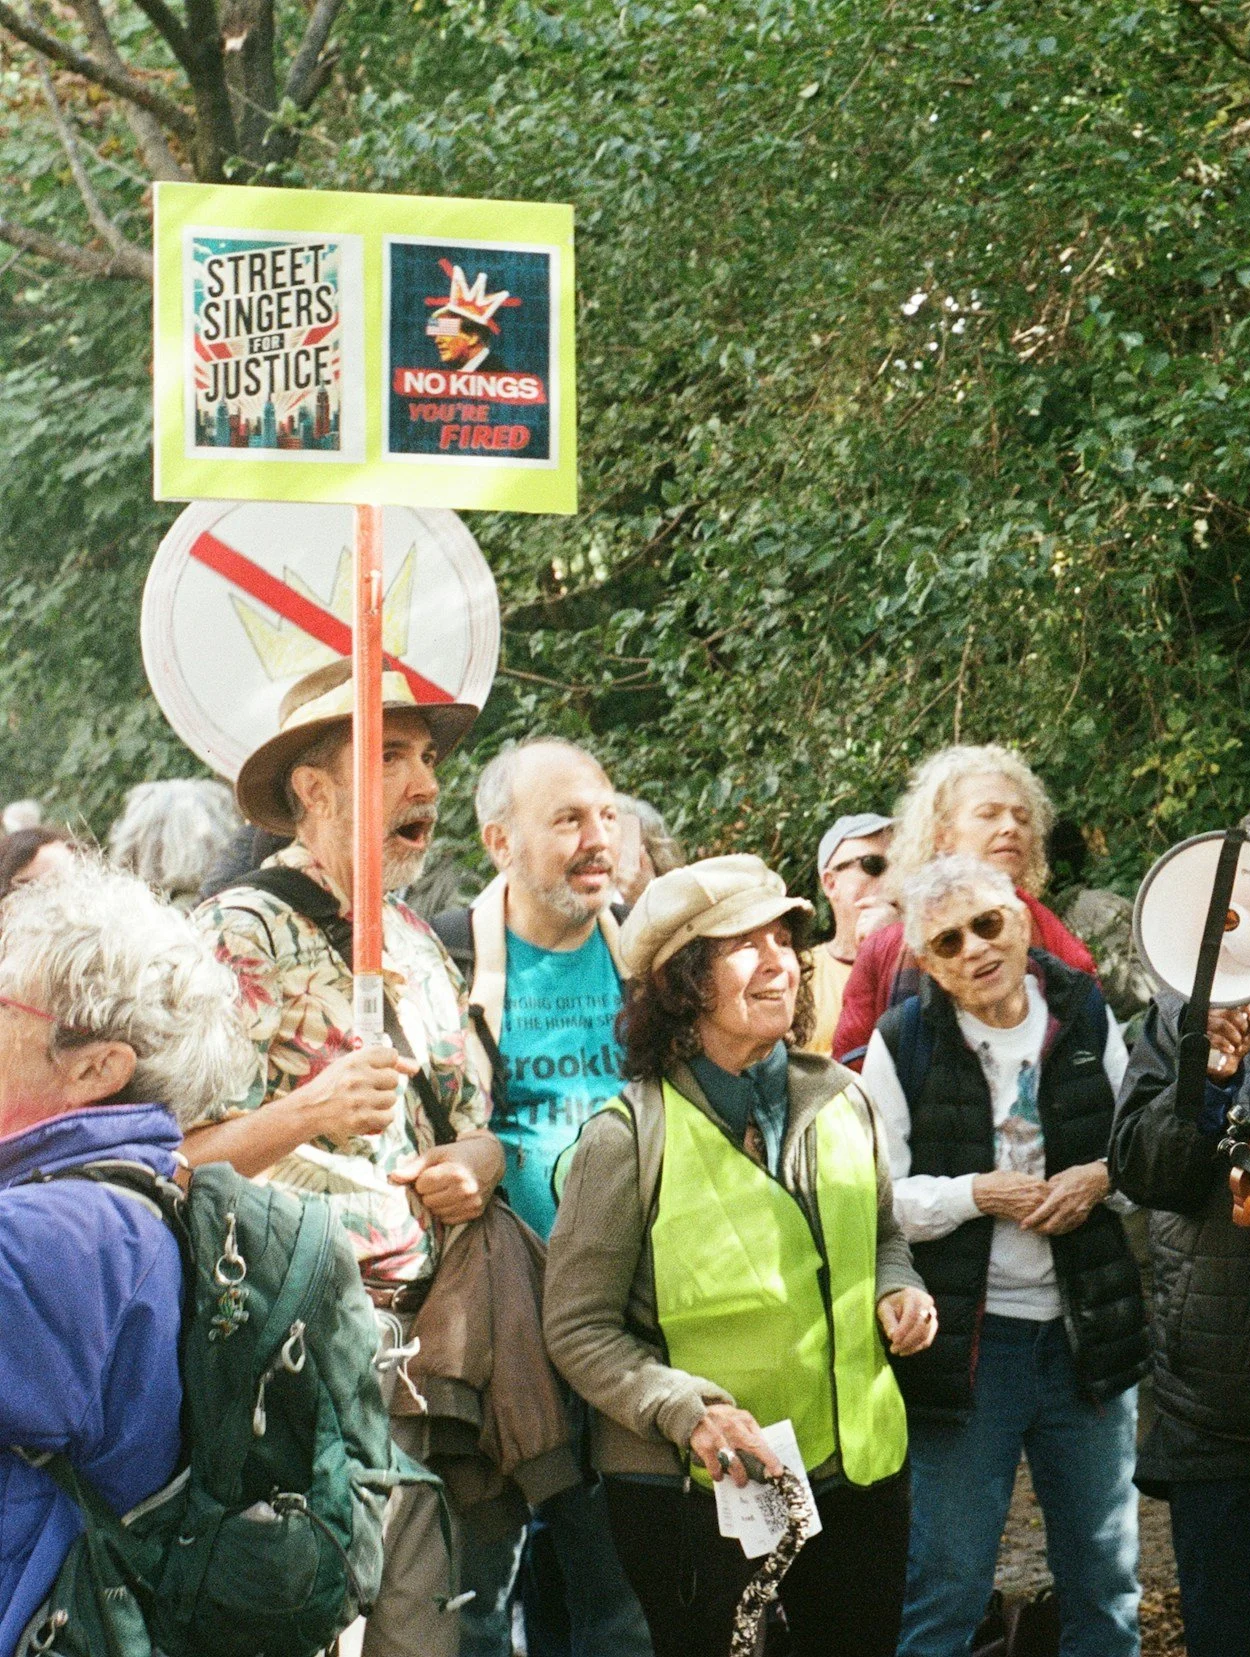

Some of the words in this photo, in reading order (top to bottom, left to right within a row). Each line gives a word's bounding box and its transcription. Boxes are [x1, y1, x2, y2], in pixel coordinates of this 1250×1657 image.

[207, 244, 325, 298] STREET
[204, 285, 333, 340] SINGERS
[253, 336, 281, 354] FOR
[205, 346, 332, 402] JUSTICE
[403, 371, 446, 395] NO
[449, 374, 539, 399] KINGS
[408, 402, 490, 423] YOU'RE
[438, 423, 531, 450] FIRED
